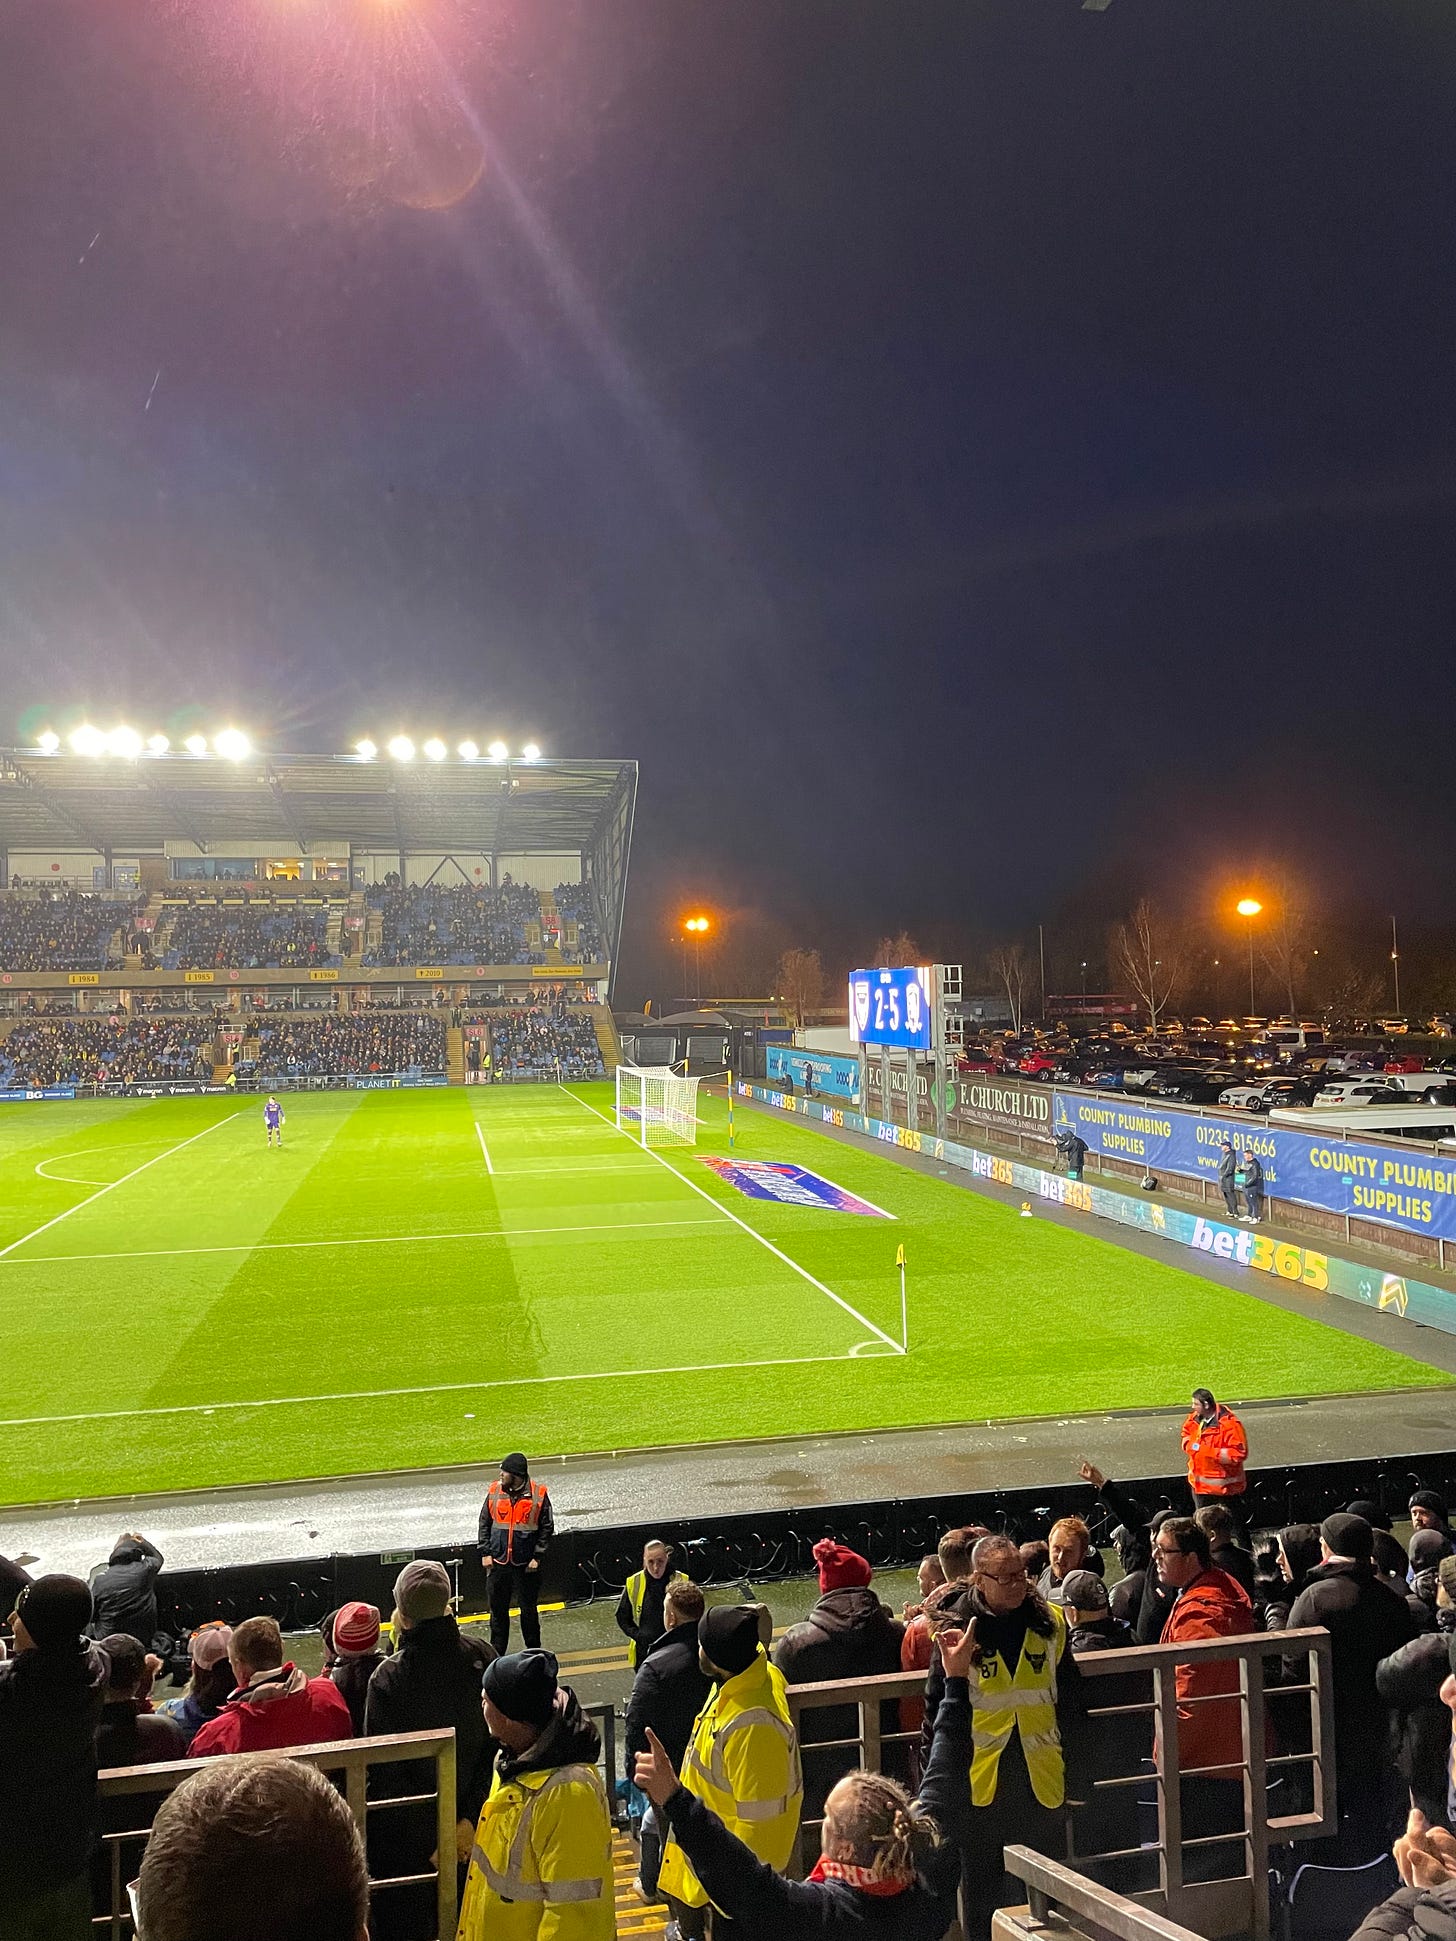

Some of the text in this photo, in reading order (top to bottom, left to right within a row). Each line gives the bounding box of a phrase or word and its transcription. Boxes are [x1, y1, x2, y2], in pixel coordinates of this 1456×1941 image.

[26, 1090, 44, 1100] BG
[356, 1080, 390, 1088] PLANET
[392, 1079, 401, 1088] IT
[772, 1090, 796, 1112] bet365
[822, 1104, 844, 1128] bet365
[960, 1084, 1048, 1120] F. CHURCH LTD
[878, 1120, 922, 1152] bet365
[1078, 1106, 1172, 1138] COUNTY PLUMBING
[1102, 1132, 1146, 1156] SUPPLIES
[1232, 1132, 1276, 1158] 815666
[972, 1150, 1014, 1185] bet365
[1310, 1147, 1378, 1178] COUNTY
[1040, 1170, 1092, 1212] bet365
[1353, 1184, 1432, 1223] SUPPLIES
[1191, 1216, 1330, 1291] bet365
[981, 1660, 998, 1679] 87
